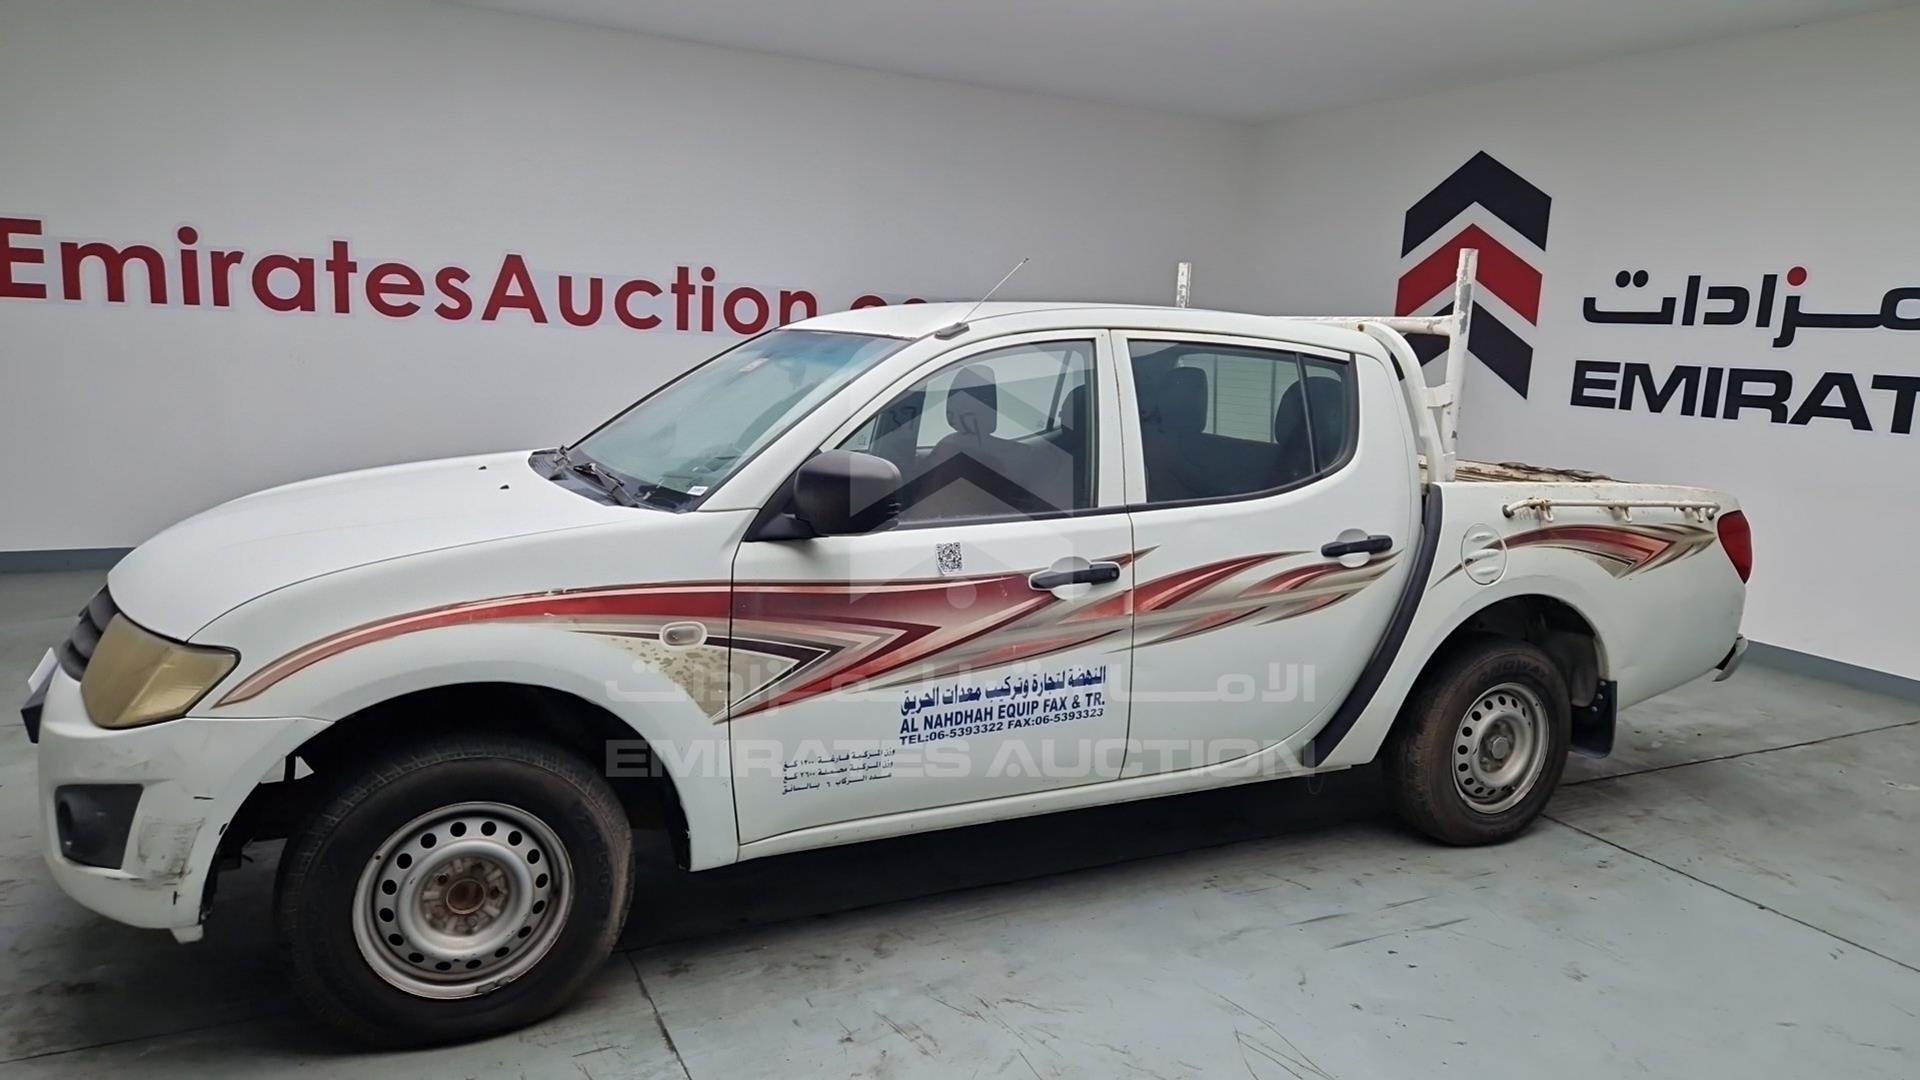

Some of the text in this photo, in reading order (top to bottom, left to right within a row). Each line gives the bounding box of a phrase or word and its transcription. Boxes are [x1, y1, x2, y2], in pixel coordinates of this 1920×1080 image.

[0, 216, 928, 336] EmiratesAuction
[1570, 359, 1920, 435] EMIRAT
[900, 664, 1106, 716] النهضة لتجارة وتركيب معدات الحريق
[900, 691, 1105, 735] AL NAHDHAH EQUIP FAX & TR.
[900, 708, 1104, 746] TEL:06-5393322 FAX:06-5393323
